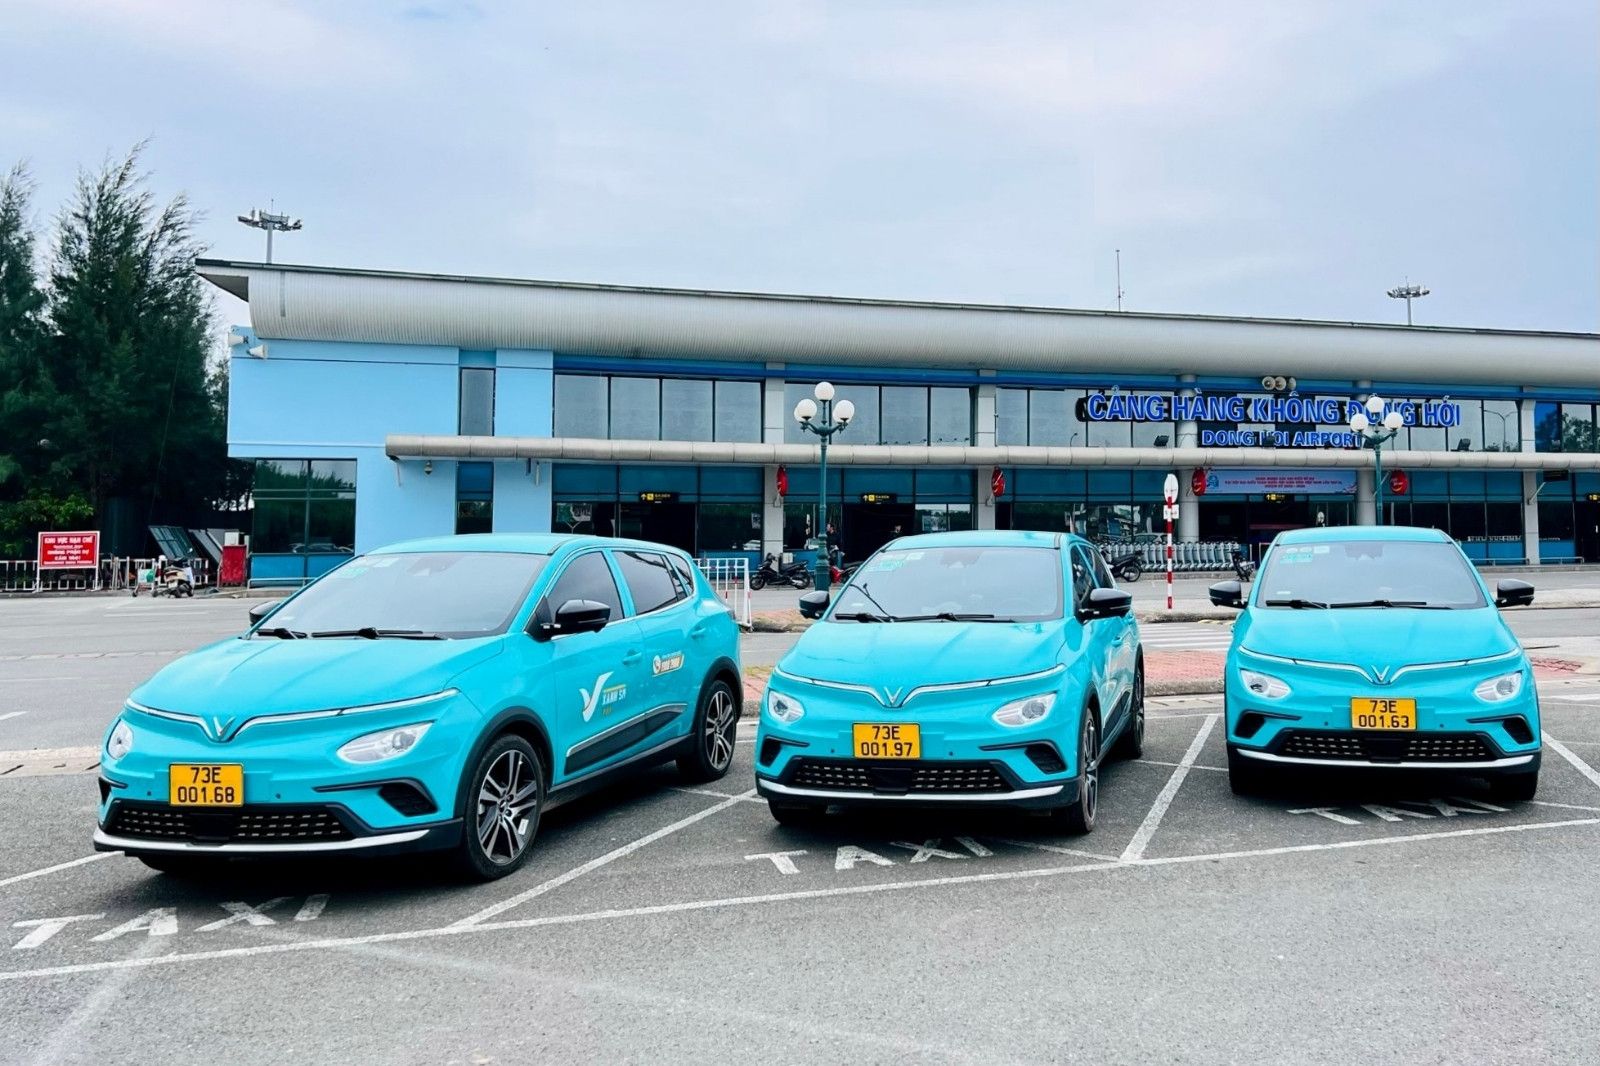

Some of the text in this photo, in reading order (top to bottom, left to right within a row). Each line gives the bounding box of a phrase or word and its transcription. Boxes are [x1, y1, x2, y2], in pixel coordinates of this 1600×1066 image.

[1088, 385, 1164, 421] CẢNG
[1171, 388, 1244, 421] HÀNG
[1252, 391, 1341, 423] KHÔNG
[1202, 430, 1255, 446] DONG
[1292, 432, 1363, 448] AIRPORT
[1370, 700, 1397, 713] 73E
[1358, 715, 1409, 728] 001.63
[872, 726, 900, 740] 73E
[861, 742, 912, 756] 001.97
[190, 767, 221, 783] 73E
[178, 786, 234, 803] 001.68
[12, 893, 330, 949] TAXI
